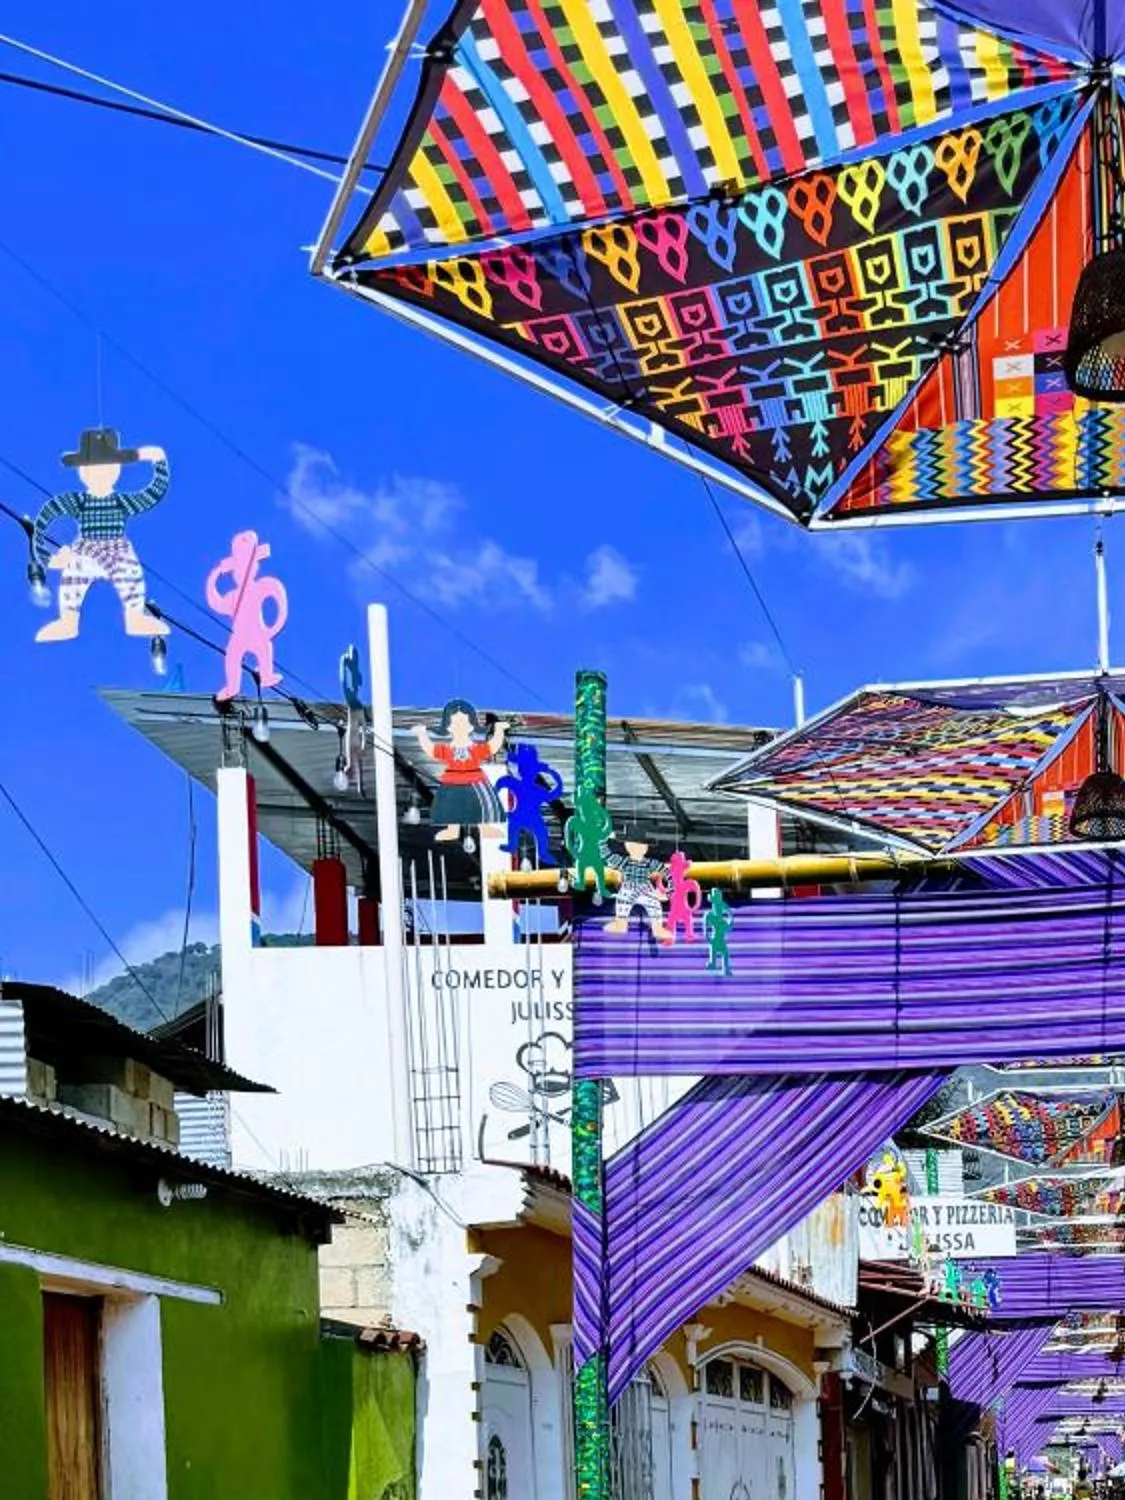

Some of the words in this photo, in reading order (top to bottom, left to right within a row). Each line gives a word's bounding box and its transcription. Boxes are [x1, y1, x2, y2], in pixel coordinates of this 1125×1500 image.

[431, 969, 544, 990] COMEDOR
[551, 969, 564, 988] Y
[932, 1205, 943, 1226] Y
[946, 1204, 1013, 1225] PIZZERIA
